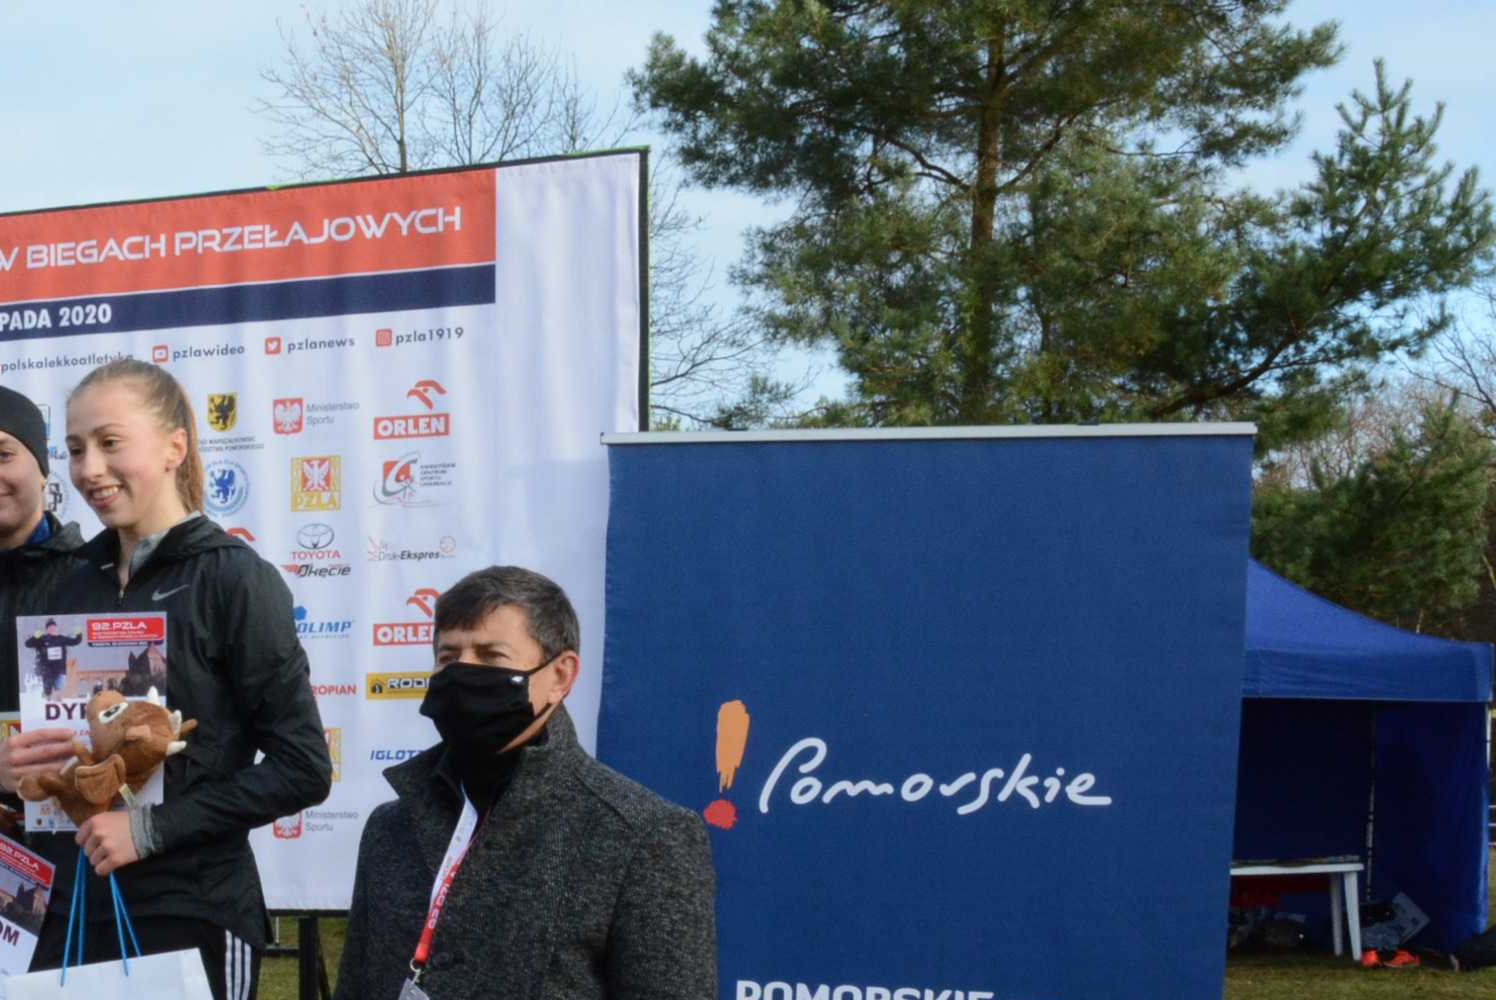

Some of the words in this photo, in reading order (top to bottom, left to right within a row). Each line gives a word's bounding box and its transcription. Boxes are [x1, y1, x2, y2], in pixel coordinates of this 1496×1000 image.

[26, 233, 167, 270] BIEGACH
[174, 206, 463, 256] PRZEŁAJOWYCH
[59, 303, 113, 327] 2020
[395, 326, 465, 346] pzla1919
[172, 343, 245, 361] pzlawideo
[287, 336, 356, 354] pzlanews
[305, 401, 360, 413] Ministerstwo
[305, 415, 335, 427] Sportu
[376, 417, 447, 437] ORLEN
[291, 550, 342, 560] TOYOTA
[296, 621, 353, 633] OLIMP
[370, 750, 425, 760] IGLOT
[757, 736, 1113, 816] Pomorskie
[305, 810, 359, 819] Ministerstwo
[305, 822, 334, 832] Sportu
